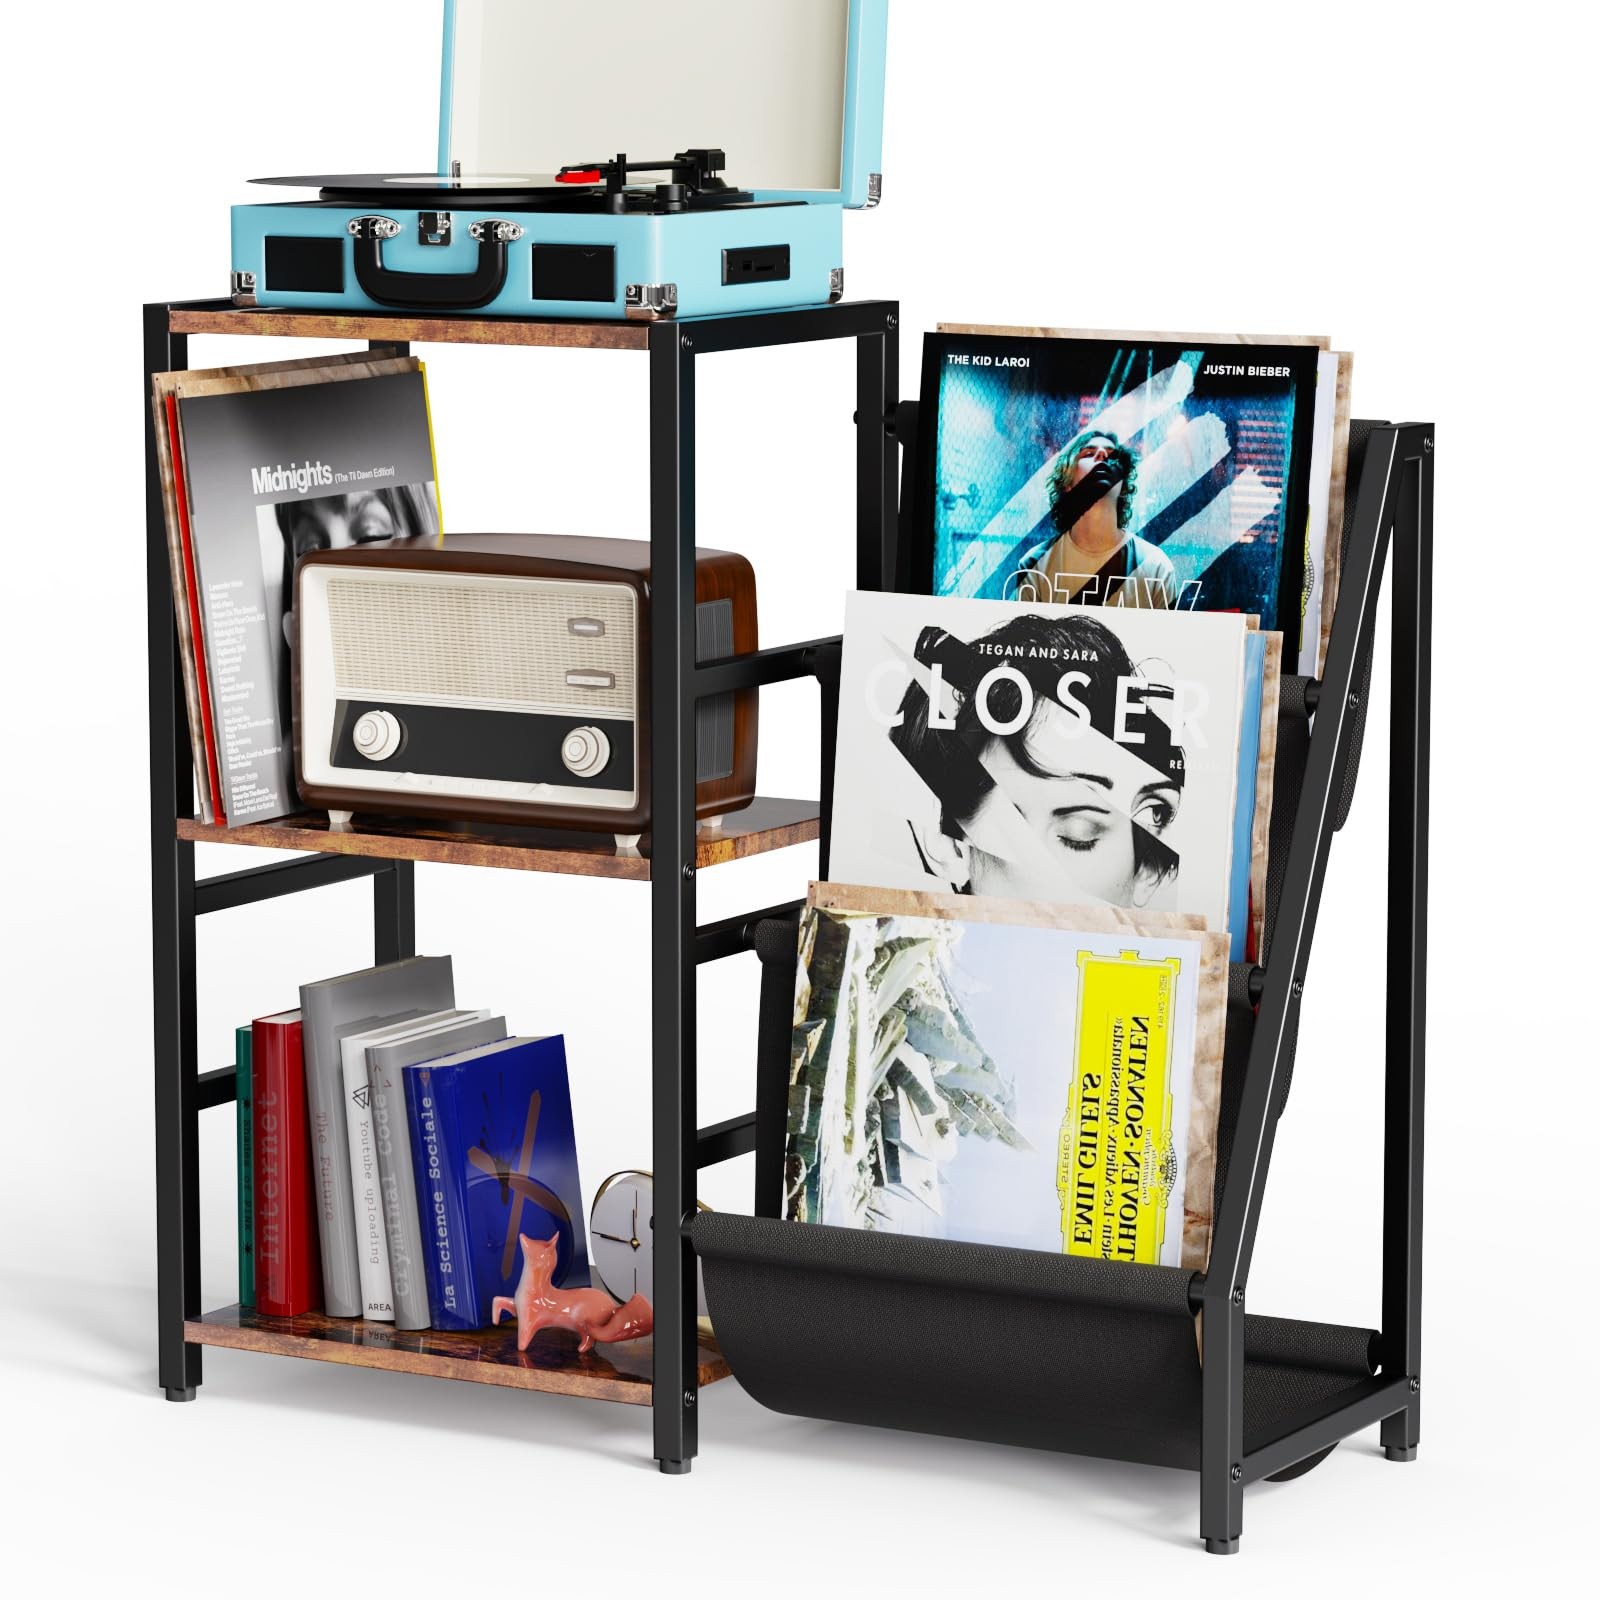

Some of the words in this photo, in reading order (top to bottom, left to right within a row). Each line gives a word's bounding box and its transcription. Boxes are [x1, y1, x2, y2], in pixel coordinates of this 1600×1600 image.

[947, 354, 970, 365] THE
[972, 355, 992, 366] KID
[994, 356, 1030, 368] LAROI
[1203, 364, 1245, 376] JUSTIN
[1247, 366, 1291, 377] BIEBER
[251, 460, 333, 495] Midnights
[357, 469, 373, 480] Dawn
[373, 465, 395, 478] Edition)
[979, 643, 1024, 658] TEGAN
[1028, 646, 1059, 660] AND
[1063, 648, 1099, 662] SARA
[864, 660, 1211, 749] CLOSER
[315, 1111, 329, 1145] The
[421, 1096, 442, 1179] Sociale
[258, 1091, 279, 1265] Internet
[320, 1156, 335, 1222] Future
[359, 1120, 373, 1180] Youtube
[366, 1188, 380, 1265] uploading
[433, 1190, 453, 1274] Science
[368, 1303, 392, 1312] AREA
[444, 1284, 457, 1310] La
